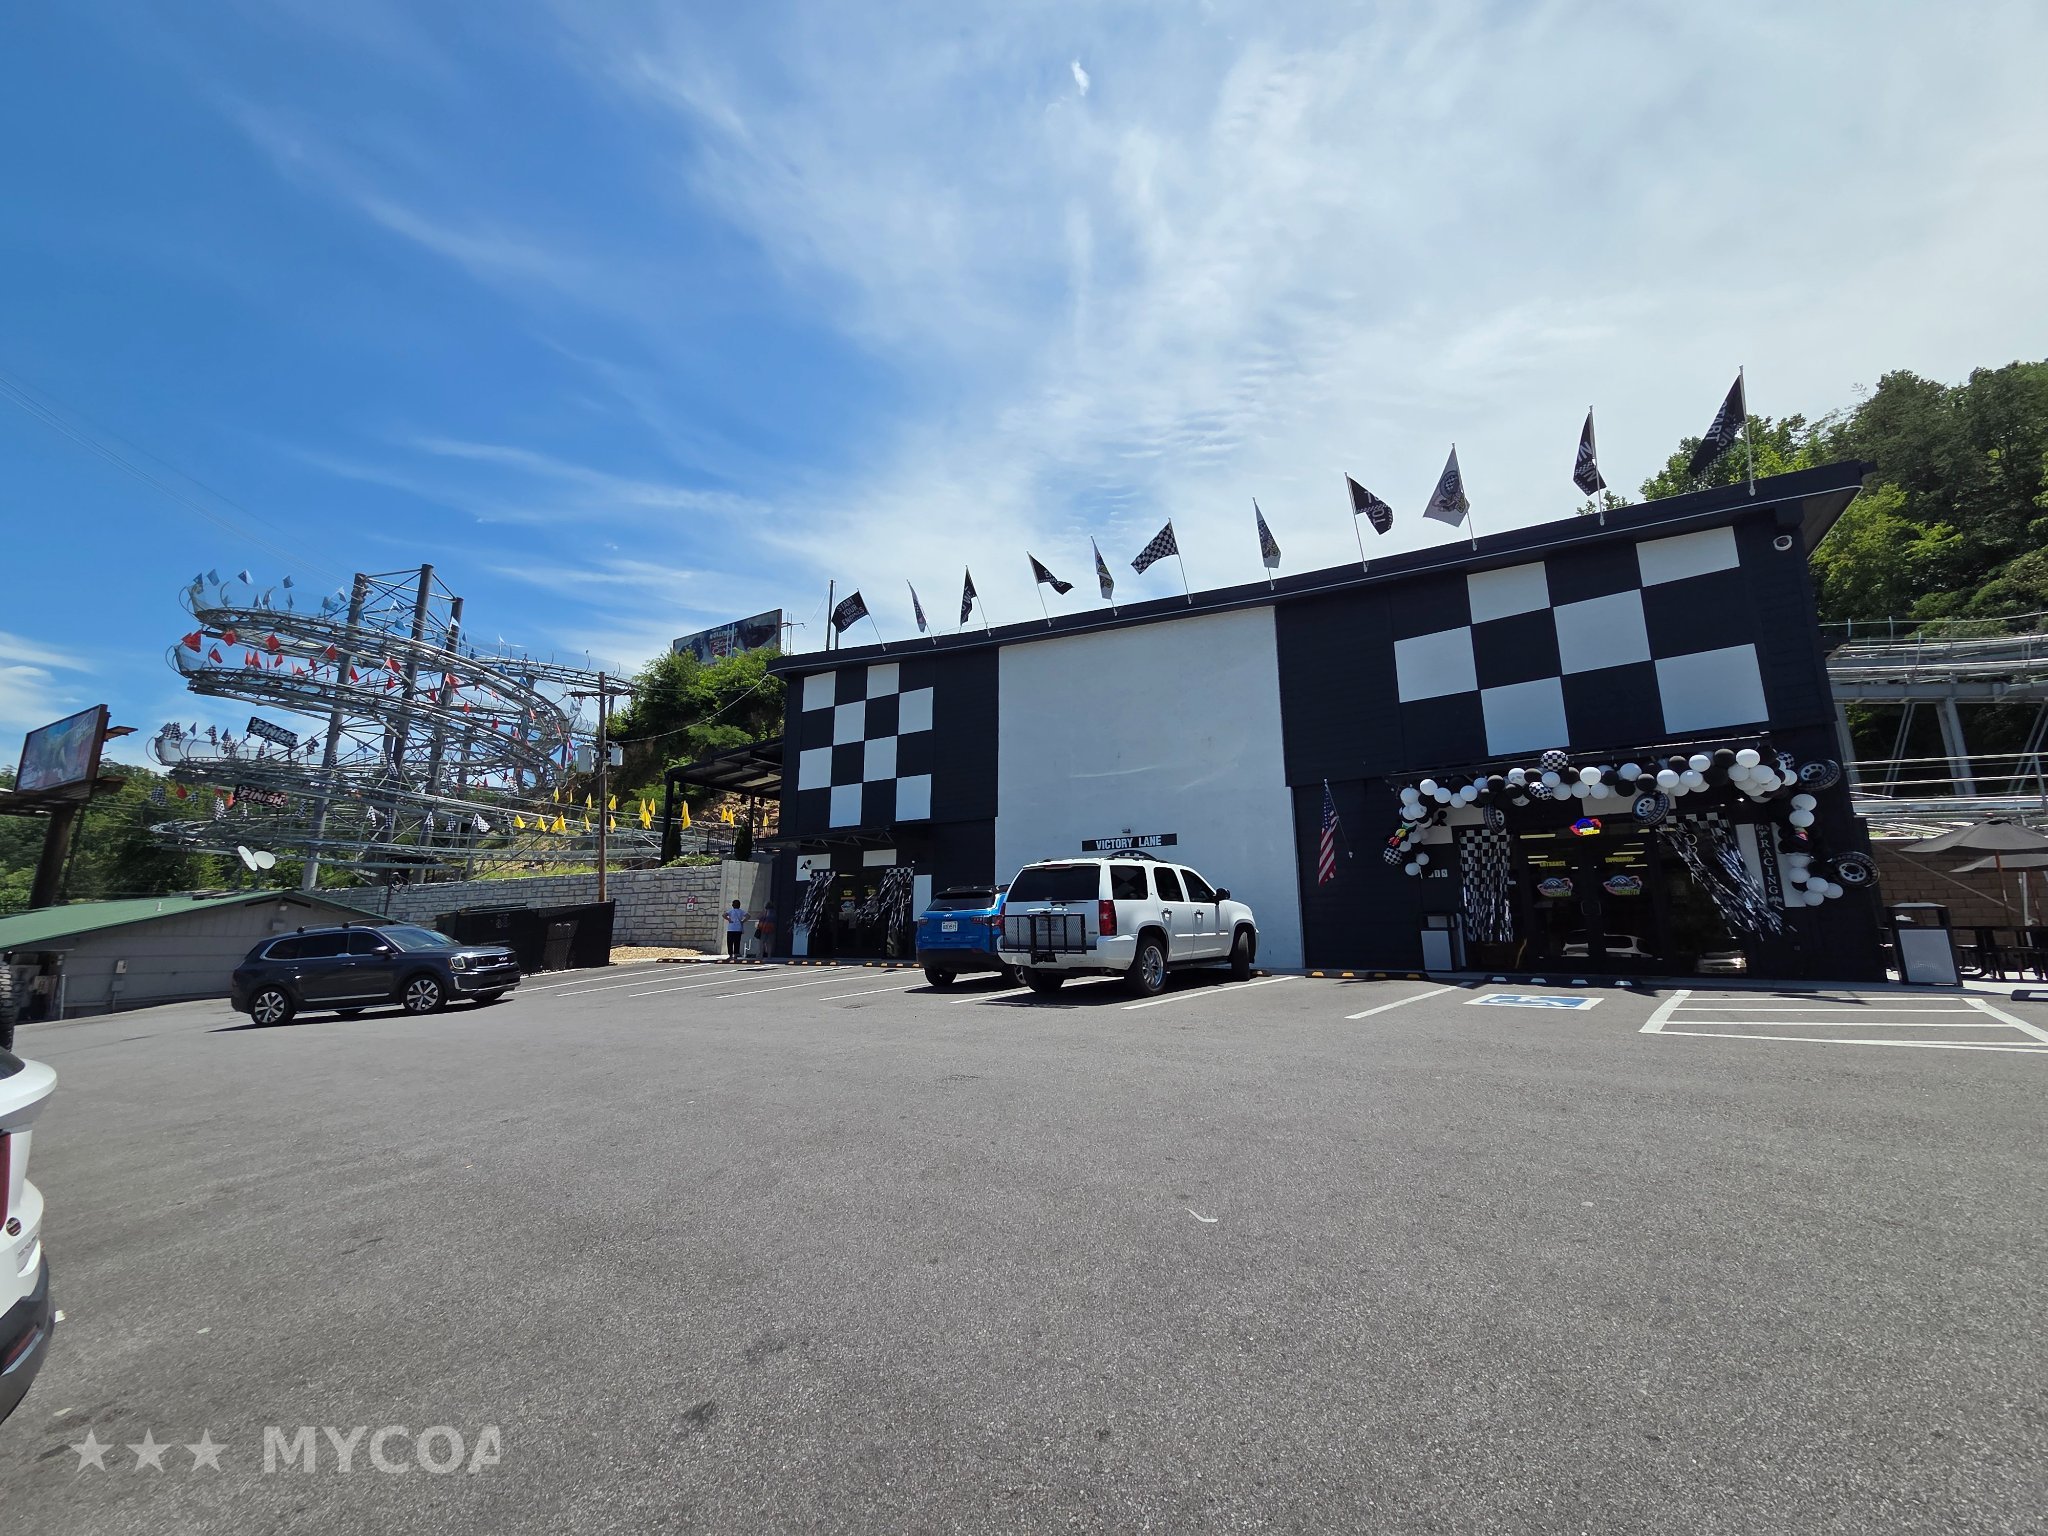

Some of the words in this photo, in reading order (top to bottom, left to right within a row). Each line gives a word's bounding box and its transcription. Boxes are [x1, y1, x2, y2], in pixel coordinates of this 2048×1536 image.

[837, 598, 855, 611] START
[842, 604, 858, 618] YOUR
[253, 721, 295, 745] FINISH
[240, 789, 283, 805] FINISH
[1096, 838, 1133, 849] VICTORY
[1138, 836, 1161, 846] LANE
[1760, 839, 1779, 895] RACING
